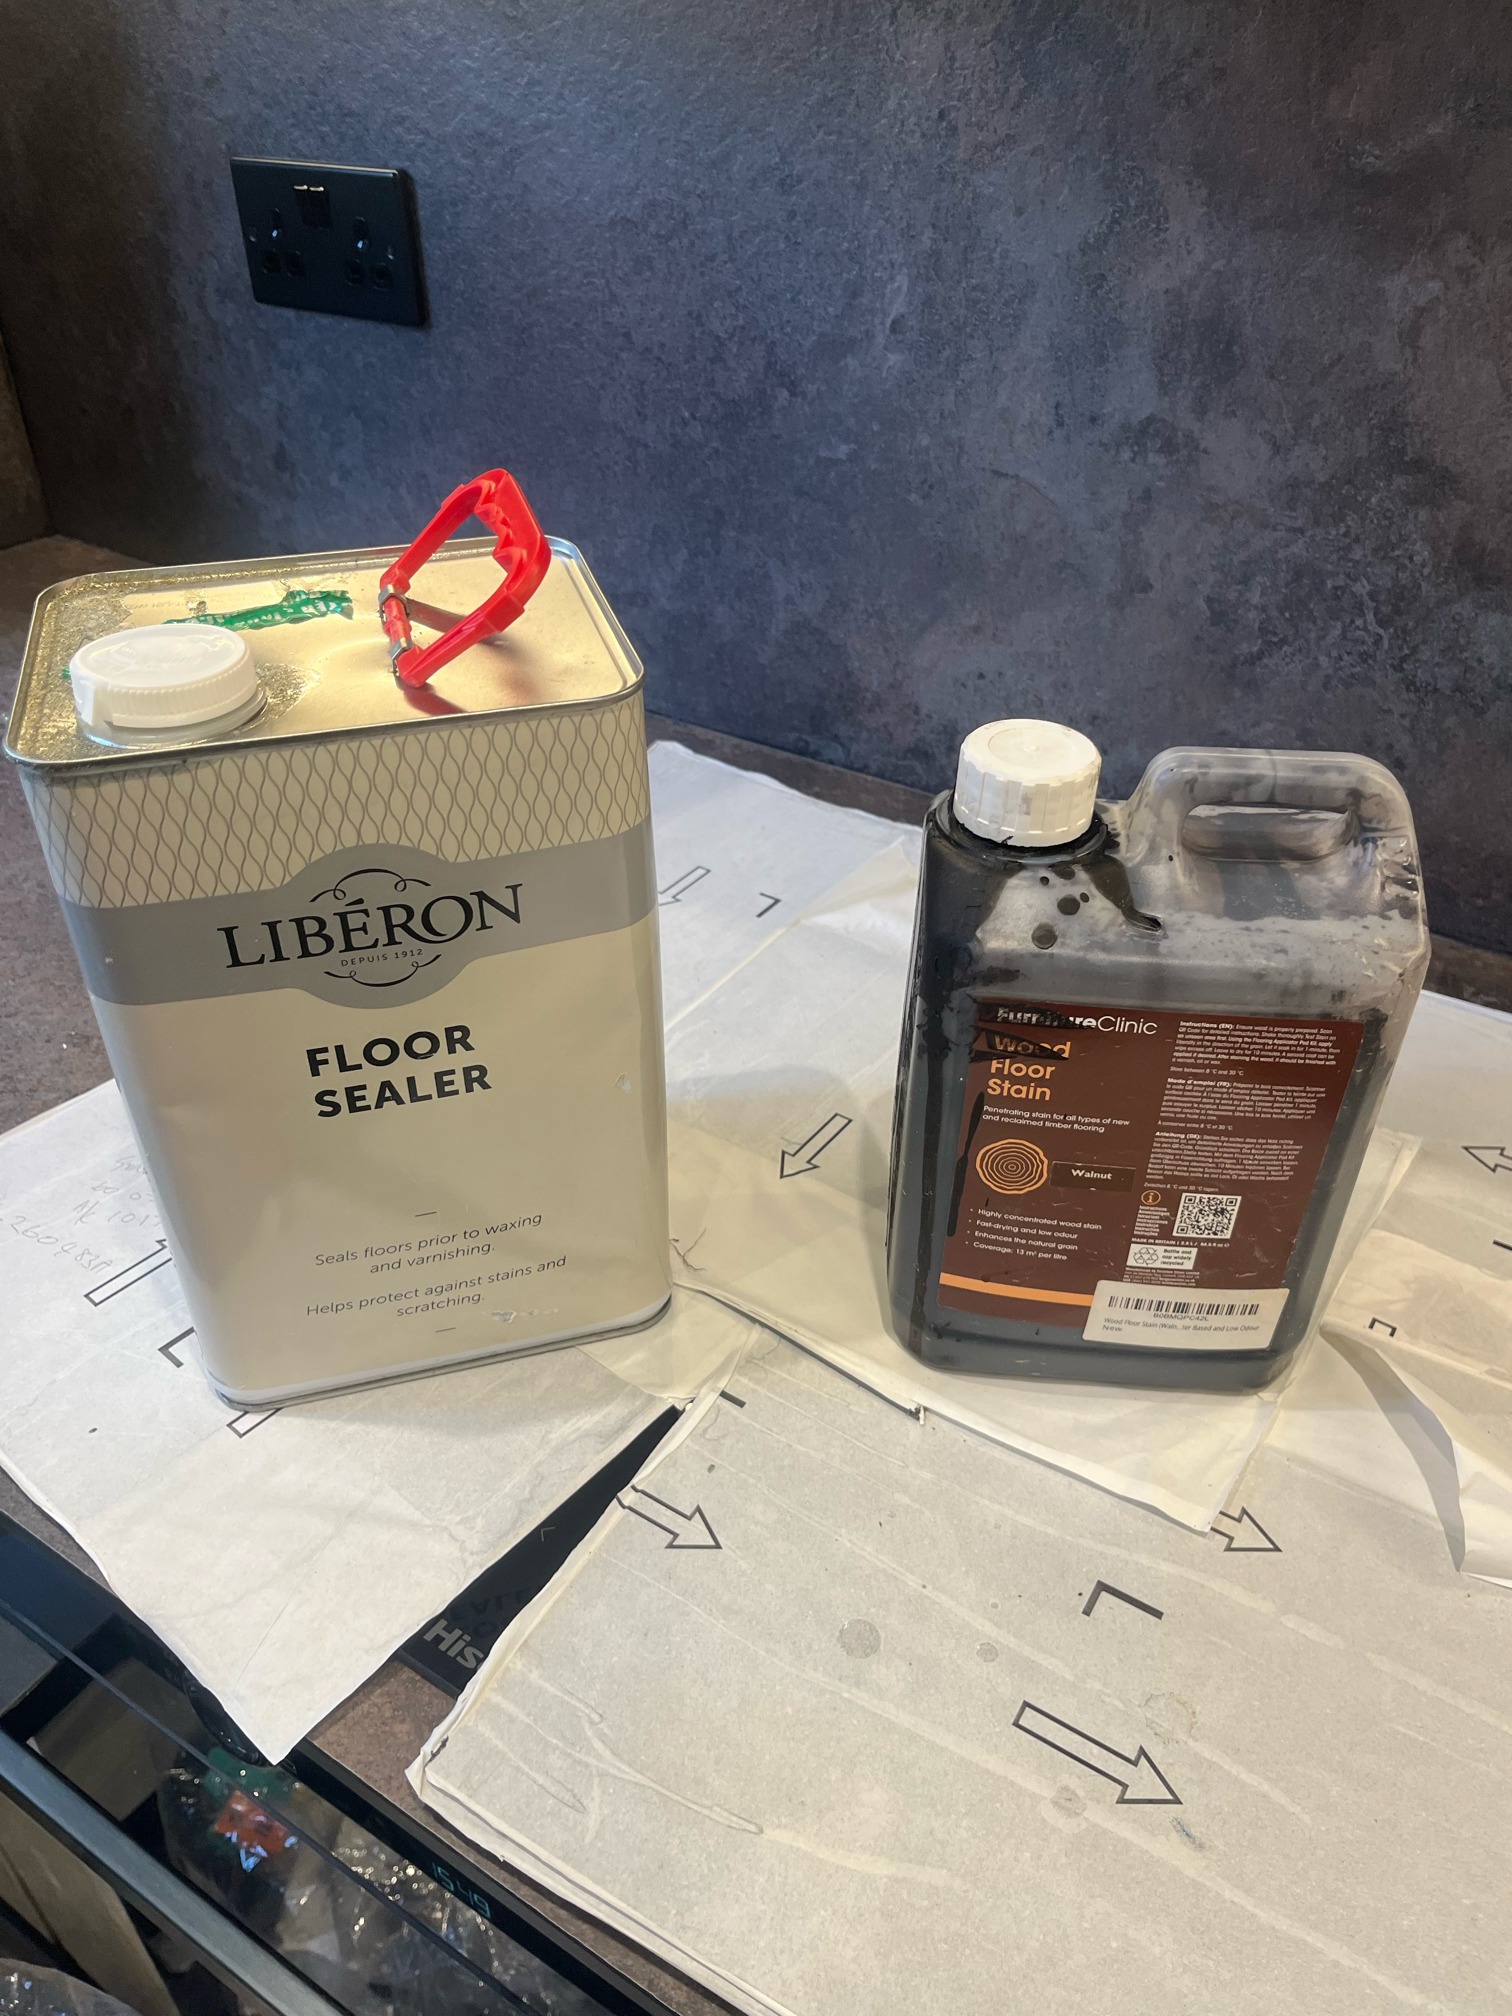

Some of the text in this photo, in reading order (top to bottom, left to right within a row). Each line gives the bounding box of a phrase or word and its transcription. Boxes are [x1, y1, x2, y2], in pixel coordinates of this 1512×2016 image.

[217, 883, 523, 968] LIBÉRON
[341, 948, 424, 967] DEPUIS 1912
[306, 1024, 475, 1077] FLOOR
[990, 1058, 1055, 1079] Floor
[314, 1064, 492, 1118] SEALER
[987, 1078, 1050, 1100] Stain
[984, 1105, 1030, 1118] Penetrating
[1078, 1115, 1100, 1124] types
[1001, 1116, 1043, 1126] reclaimed
[1045, 1121, 1071, 1129] timber
[1073, 1124, 1104, 1133] flooring
[1071, 1168, 1112, 1180] Walnut
[978, 1208, 1002, 1218] Highly
[1004, 1213, 1057, 1225] concentrated
[1059, 1220, 1082, 1228] wood
[315, 1214, 542, 1266] Seals floors prior to waxing
[974, 1231, 1012, 1242] Enhances
[1028, 1240, 1056, 1248] natural
[976, 1220, 1018, 1232] Fast-drying
[1054, 1231, 1078, 1239] odour
[370, 1242, 494, 1273] and varnishing.
[973, 1242, 1013, 1253] Coverage:
[307, 1256, 566, 1316] Helps protect against stains and
[397, 1292, 485, 1317] scratching.
[423, 1618, 484, 1669] His
